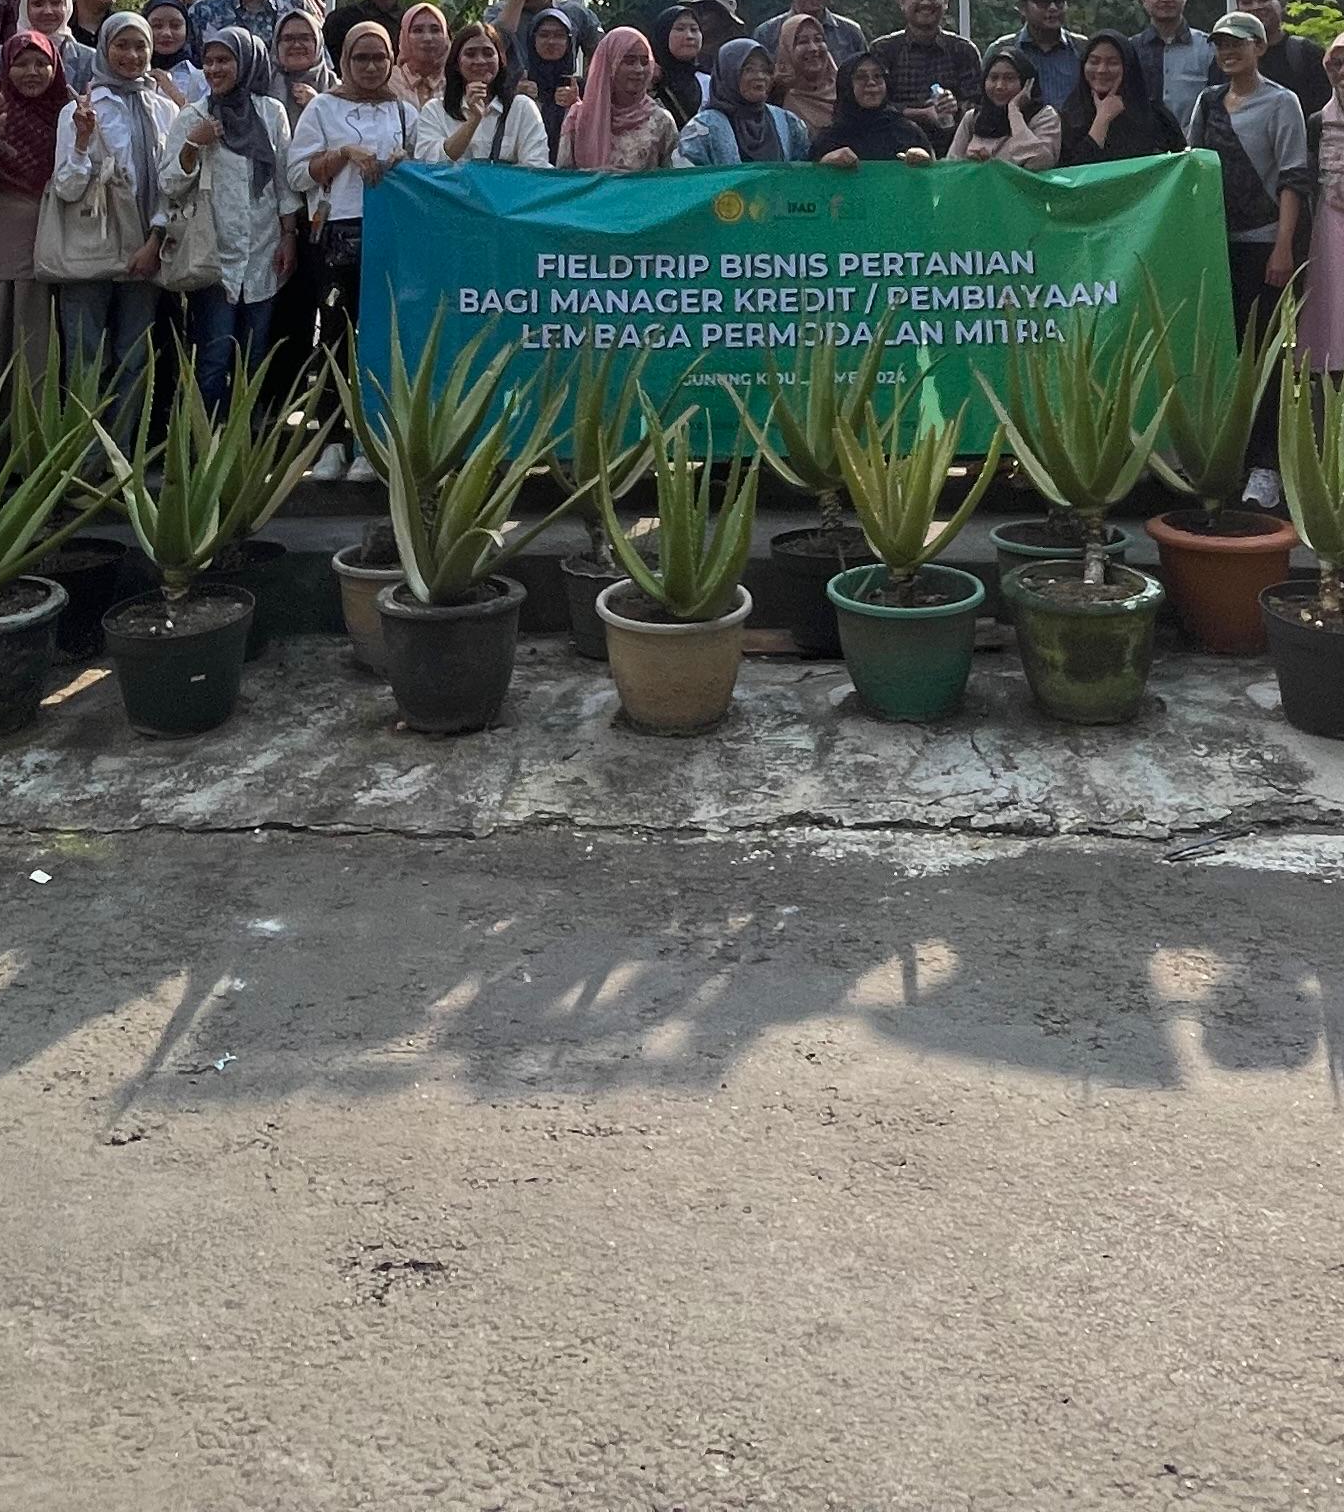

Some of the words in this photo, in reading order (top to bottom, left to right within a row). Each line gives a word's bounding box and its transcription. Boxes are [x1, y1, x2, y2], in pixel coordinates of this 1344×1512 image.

[537, 253, 709, 279] FIELDTRIP
[720, 253, 828, 279] BISNIS
[838, 250, 1035, 278] PERTANIAN
[458, 288, 539, 314] BAGI
[550, 288, 723, 314] MANAGER
[734, 288, 856, 313] KREDIT
[887, 280, 1118, 311] PEMBIAYAAN
[521, 322, 692, 349] LEMBAGA
